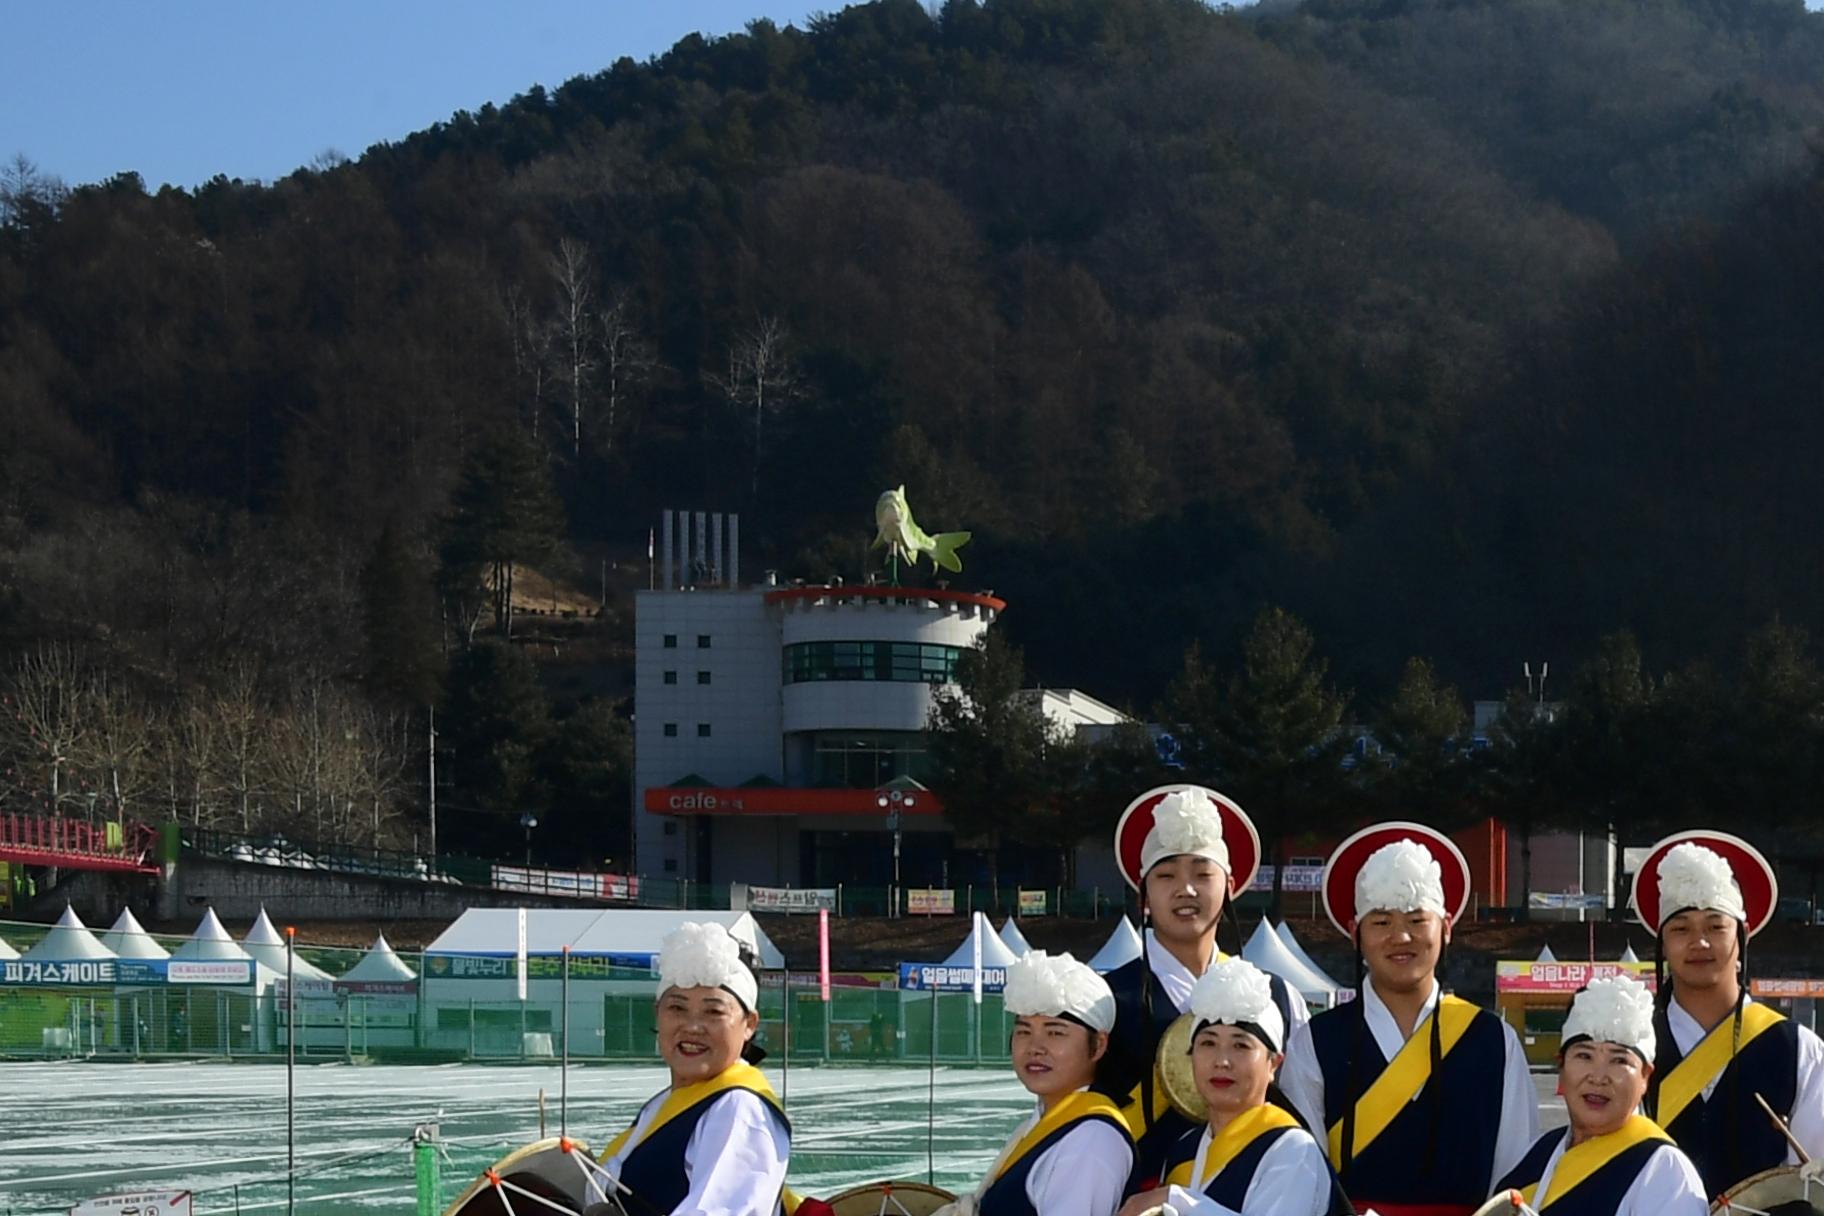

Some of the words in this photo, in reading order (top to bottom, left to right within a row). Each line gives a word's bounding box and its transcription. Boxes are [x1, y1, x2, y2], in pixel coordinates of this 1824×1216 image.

[669, 791, 717, 808] cafe
[4, 962, 117, 983] 피겨스케이트
[1531, 964, 1586, 982] 얼음나라
